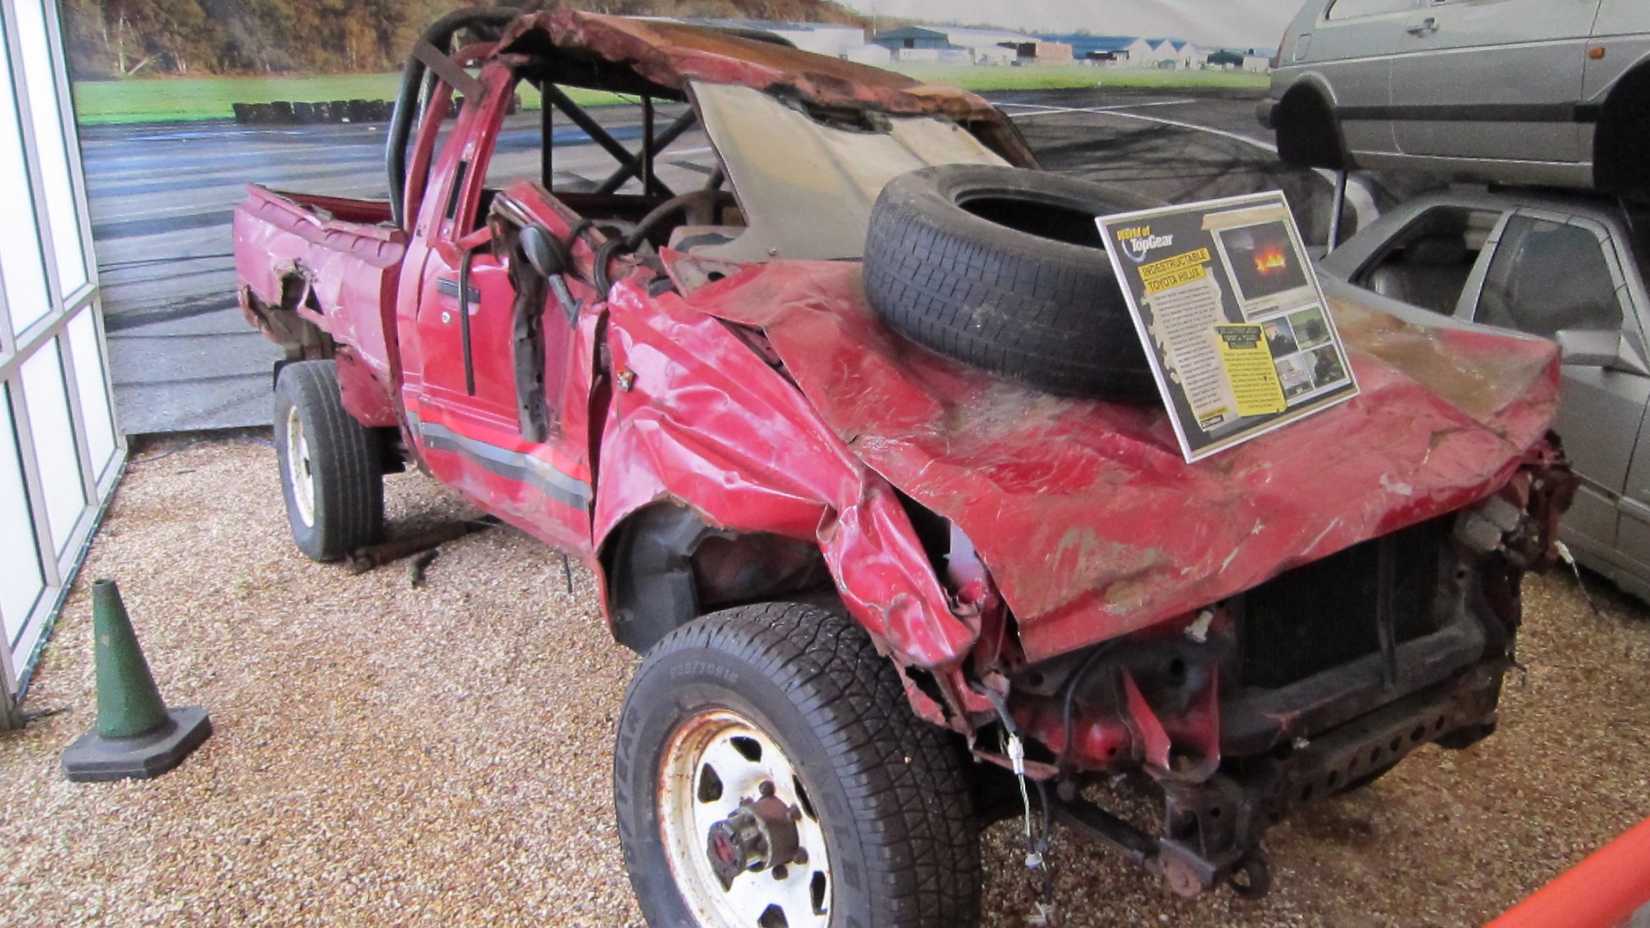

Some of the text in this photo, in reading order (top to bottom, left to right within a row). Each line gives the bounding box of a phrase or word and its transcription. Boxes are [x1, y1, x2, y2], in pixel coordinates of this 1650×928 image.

[1131, 234, 1173, 251] TopGear
[1147, 267, 1201, 291] TOYOTA HILUX
